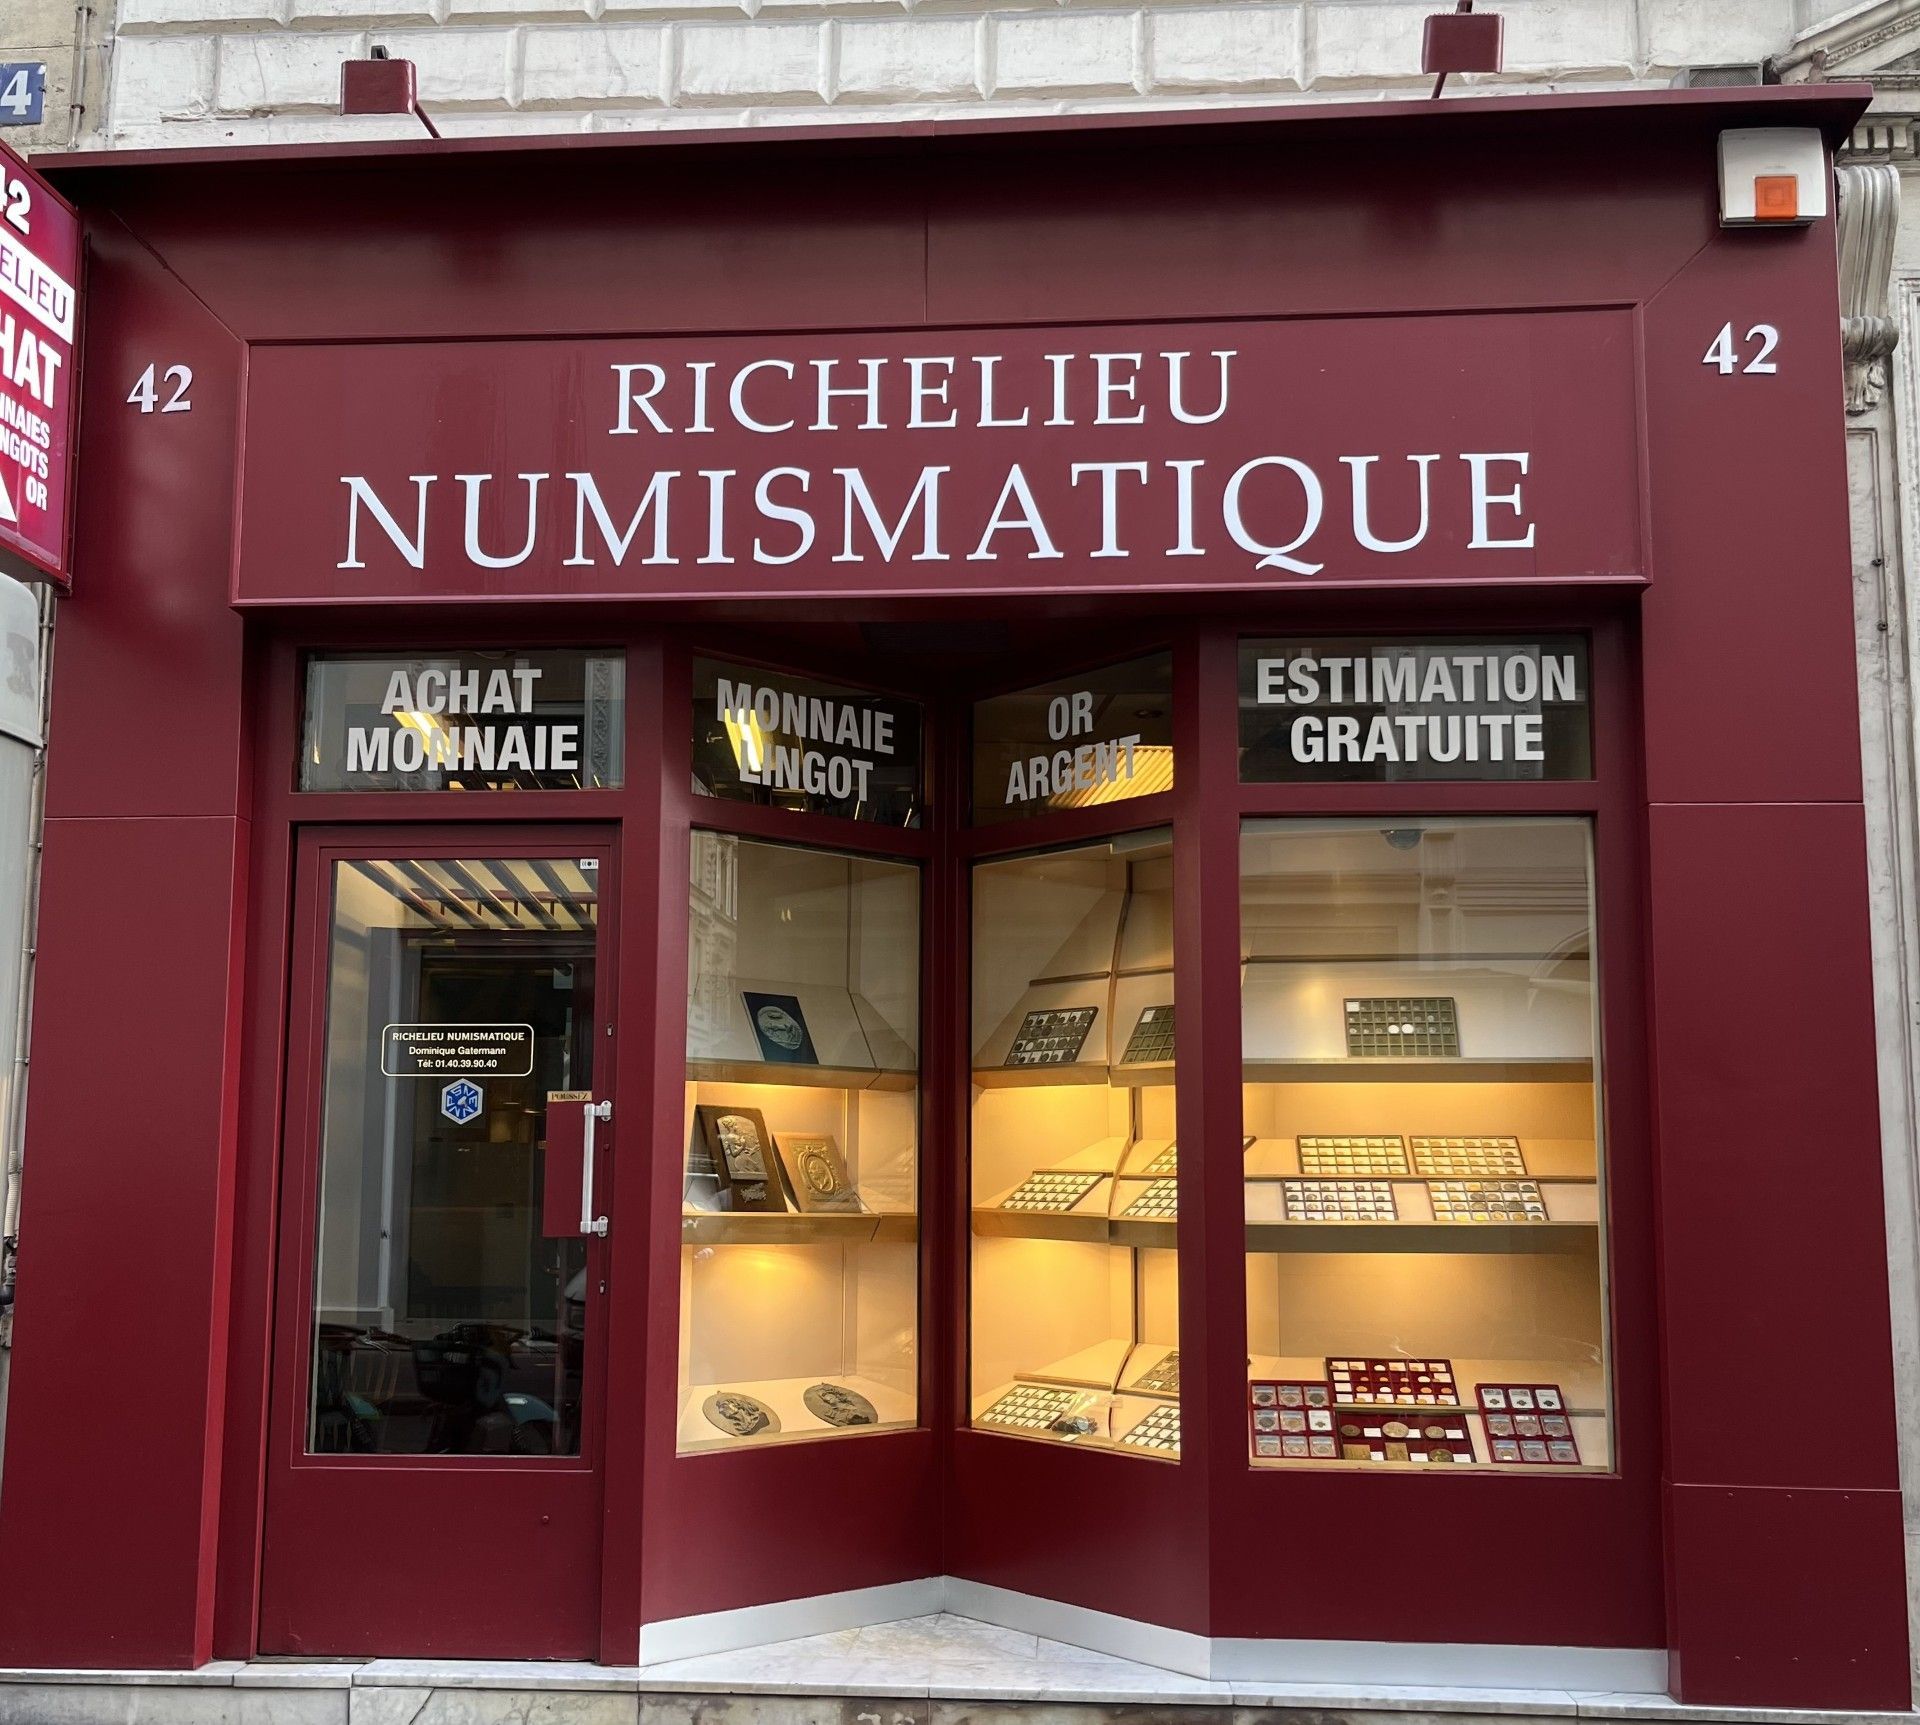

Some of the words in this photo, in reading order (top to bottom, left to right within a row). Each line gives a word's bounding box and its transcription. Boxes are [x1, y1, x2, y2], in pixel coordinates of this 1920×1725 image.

[1702, 321, 1779, 375] 42
[126, 363, 193, 414] 42
[608, 350, 1238, 435] RICHELIEU
[26, 475, 47, 511] OR
[336, 451, 1536, 576] NUMISMATIQUE
[381, 668, 542, 715] ACHAT
[1257, 655, 1576, 705] ESTIMATION
[717, 678, 895, 755] MONNAIE
[1048, 690, 1093, 740] OR
[1290, 714, 1545, 763] GRATUITE
[346, 725, 578, 772] MONNAIE
[739, 740, 874, 802] LINGOT
[1005, 734, 1141, 804] ARGENT
[392, 1032, 444, 1041] RICHELIEU
[447, 1032, 525, 1042] NUMISMATIQUE
[408, 1046, 456, 1056] Dominique
[457, 1046, 507, 1055] Gatermann
[417, 1059, 434, 1068] Tél:
[435, 1059, 498, 1068] 01.40.39.90.40
